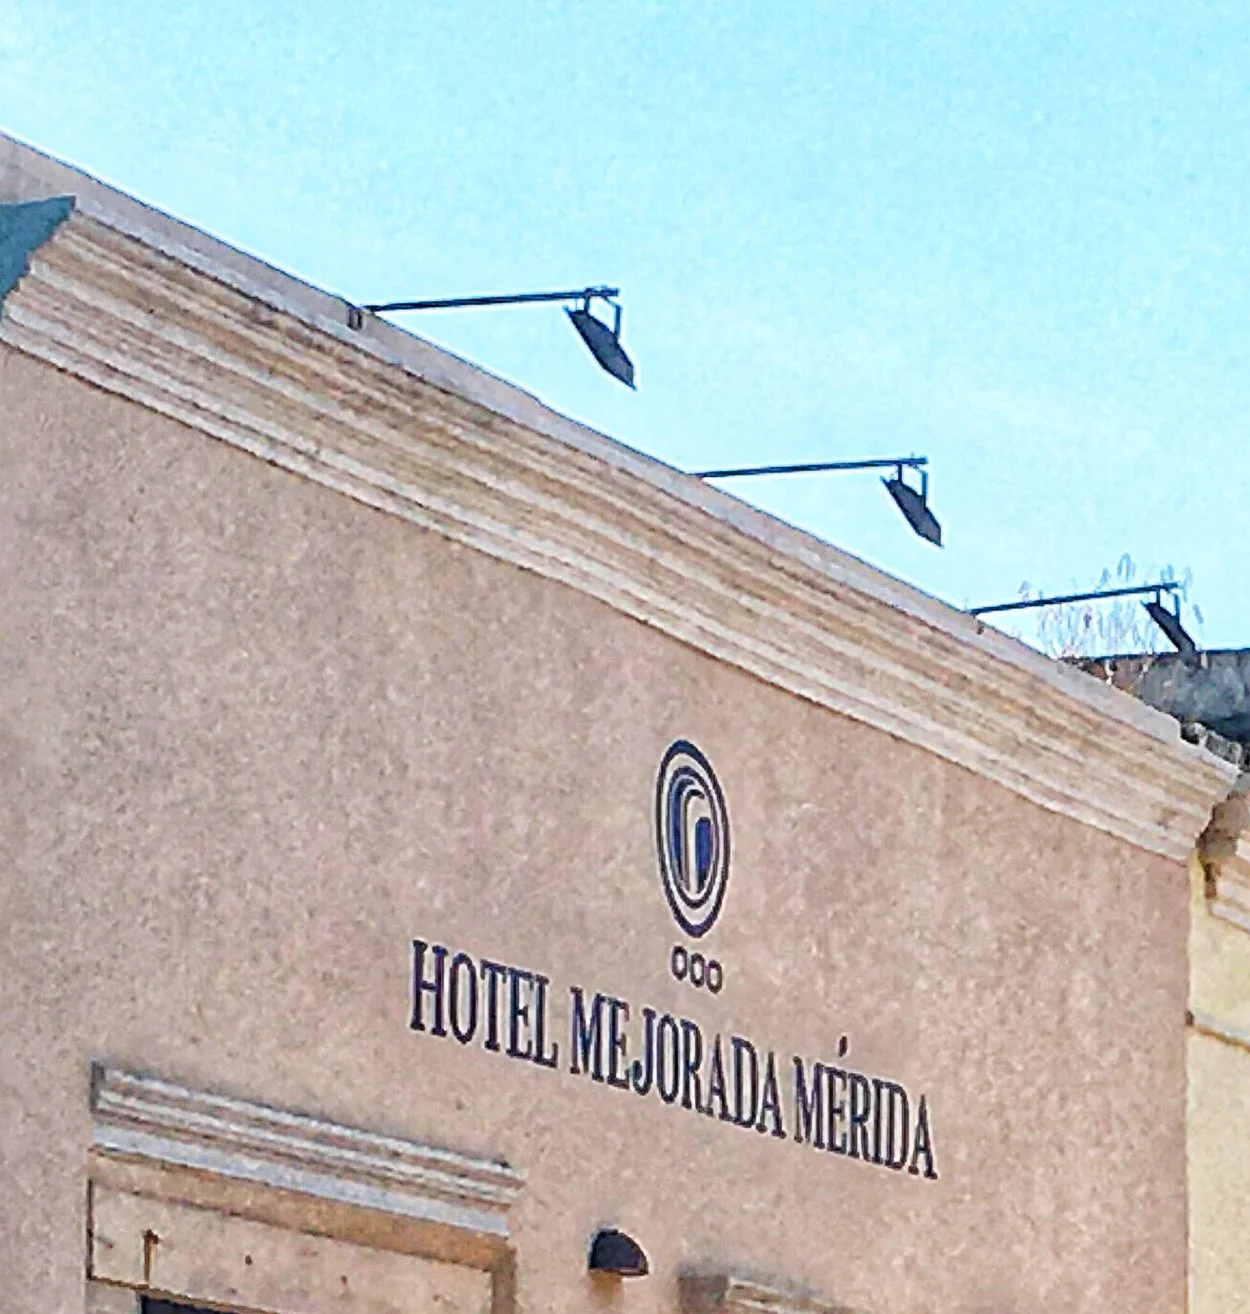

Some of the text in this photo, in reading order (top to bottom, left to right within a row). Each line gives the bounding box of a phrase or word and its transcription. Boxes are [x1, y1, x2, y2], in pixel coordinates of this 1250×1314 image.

[409, 939, 938, 1180] HOTEL MEJORADA MÉRIDA
